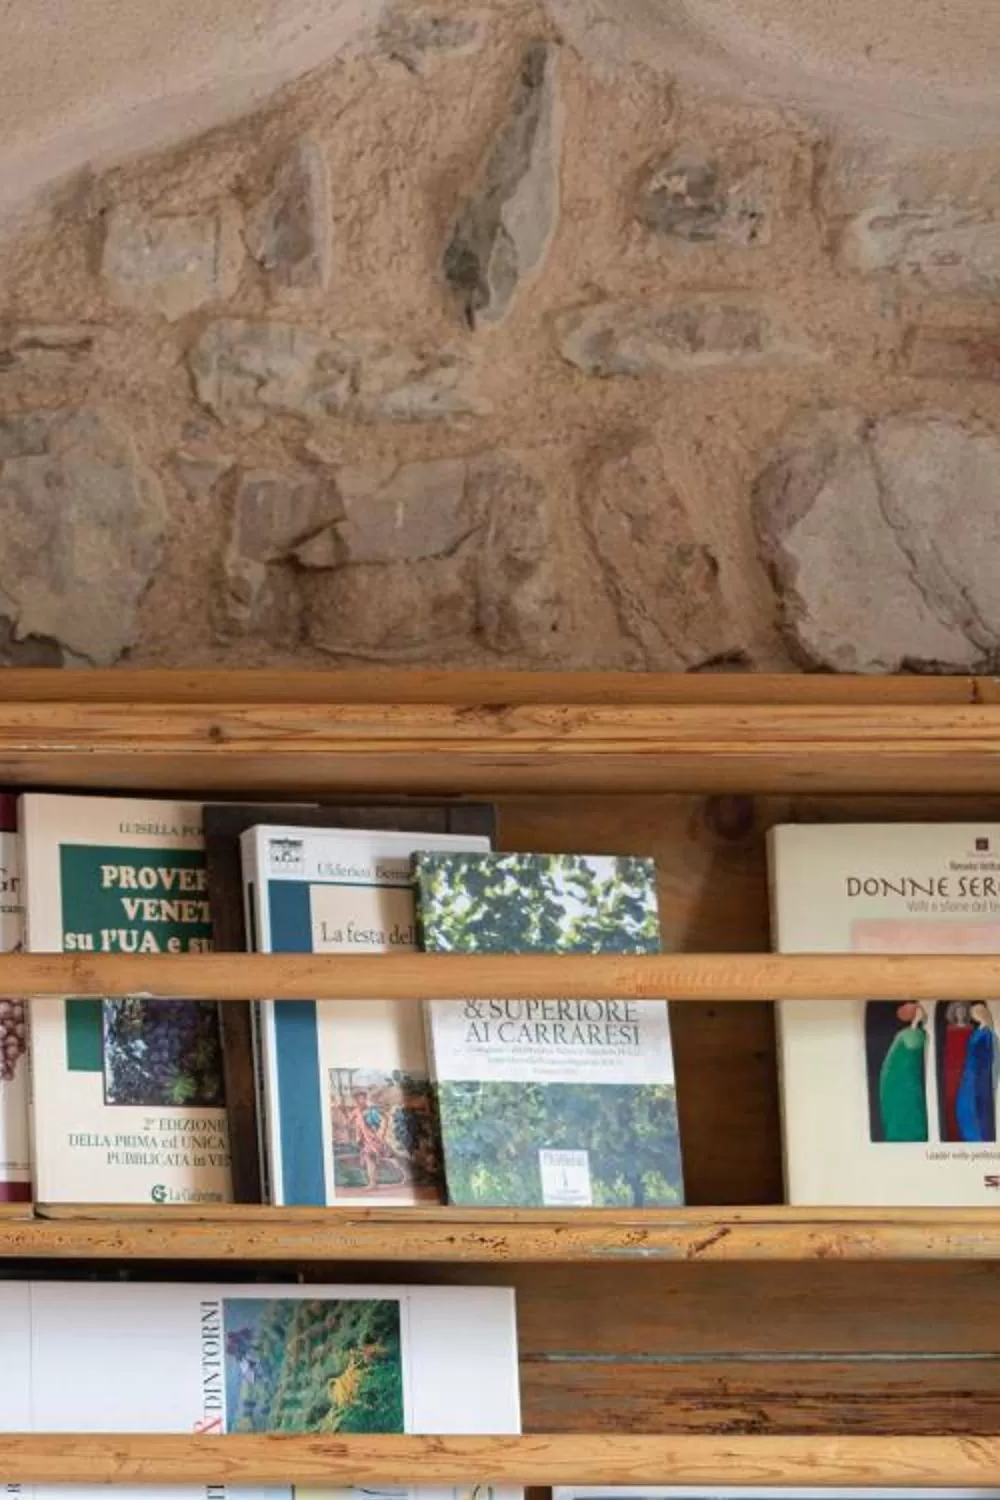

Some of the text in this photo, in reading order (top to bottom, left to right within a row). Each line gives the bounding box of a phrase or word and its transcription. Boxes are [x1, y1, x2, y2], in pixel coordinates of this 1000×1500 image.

[846, 876, 1000, 898] DONNE SER
[120, 897, 213, 923] VENET
[320, 921, 343, 942] La
[65, 933, 95, 950] su
[167, 937, 181, 953] e
[488, 999, 640, 1022] SUPERIORE
[464, 1021, 641, 1046] AI CARRARESI
[68, 1133, 111, 1148] DELLA
[114, 1134, 158, 1149] PRIMA
[106, 1151, 190, 1167] PUBBLICATA
[200, 1300, 223, 1411] DINTORNI
